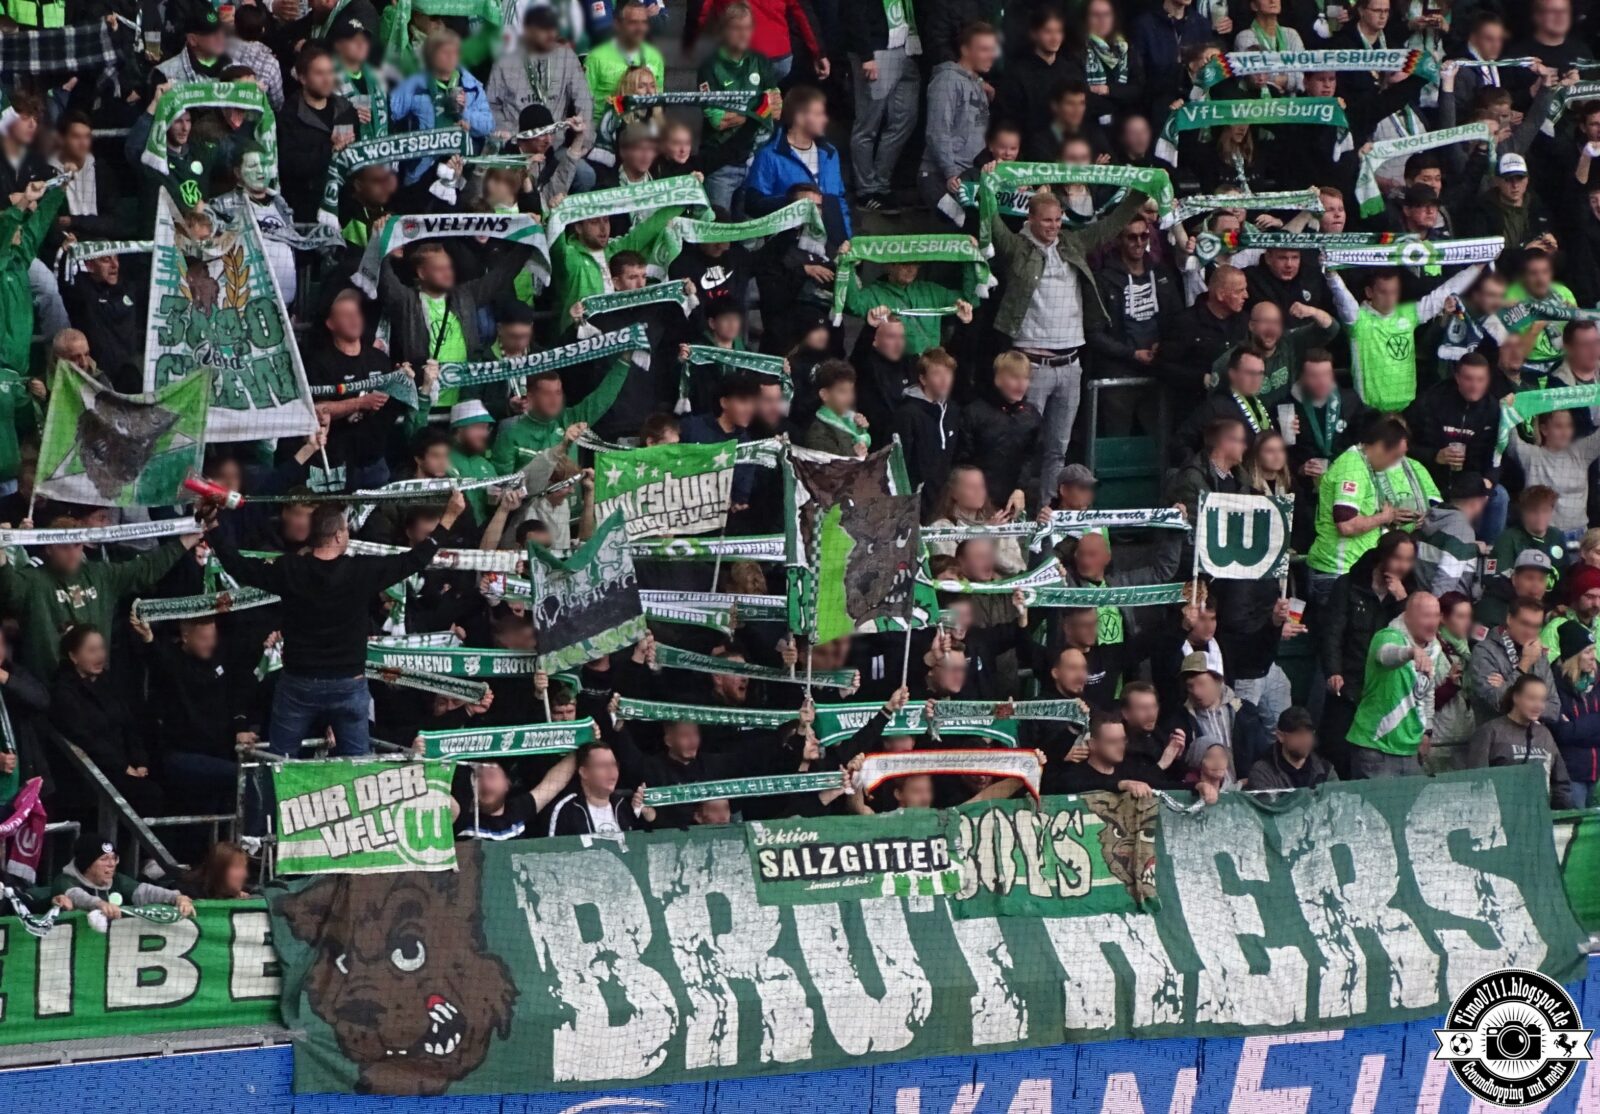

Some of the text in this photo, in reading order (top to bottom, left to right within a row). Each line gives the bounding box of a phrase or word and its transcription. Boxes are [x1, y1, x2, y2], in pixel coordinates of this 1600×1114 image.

[1281, 51, 1401, 65] WOLFSBURG
[1182, 100, 1335, 122] VfL Wolfsburg
[364, 131, 462, 159] WOLFSBURG
[1392, 123, 1487, 151] WOLFSBURG
[1005, 163, 1154, 182] WOLFSBURG
[592, 188, 632, 201] HERZ
[423, 216, 513, 233] VELTINS
[863, 238, 974, 256] WOLFSBURG
[1280, 233, 1369, 243] WOLFSBURG
[509, 325, 631, 371] WOLFSBURG
[383, 654, 453, 673] WEEKEND
[439, 730, 577, 753] WEEKEND BROTHERS
[753, 827, 819, 847] Sektion
[758, 837, 949, 878] SALZGITTER
[511, 778, 1548, 1083] BROTHERS
